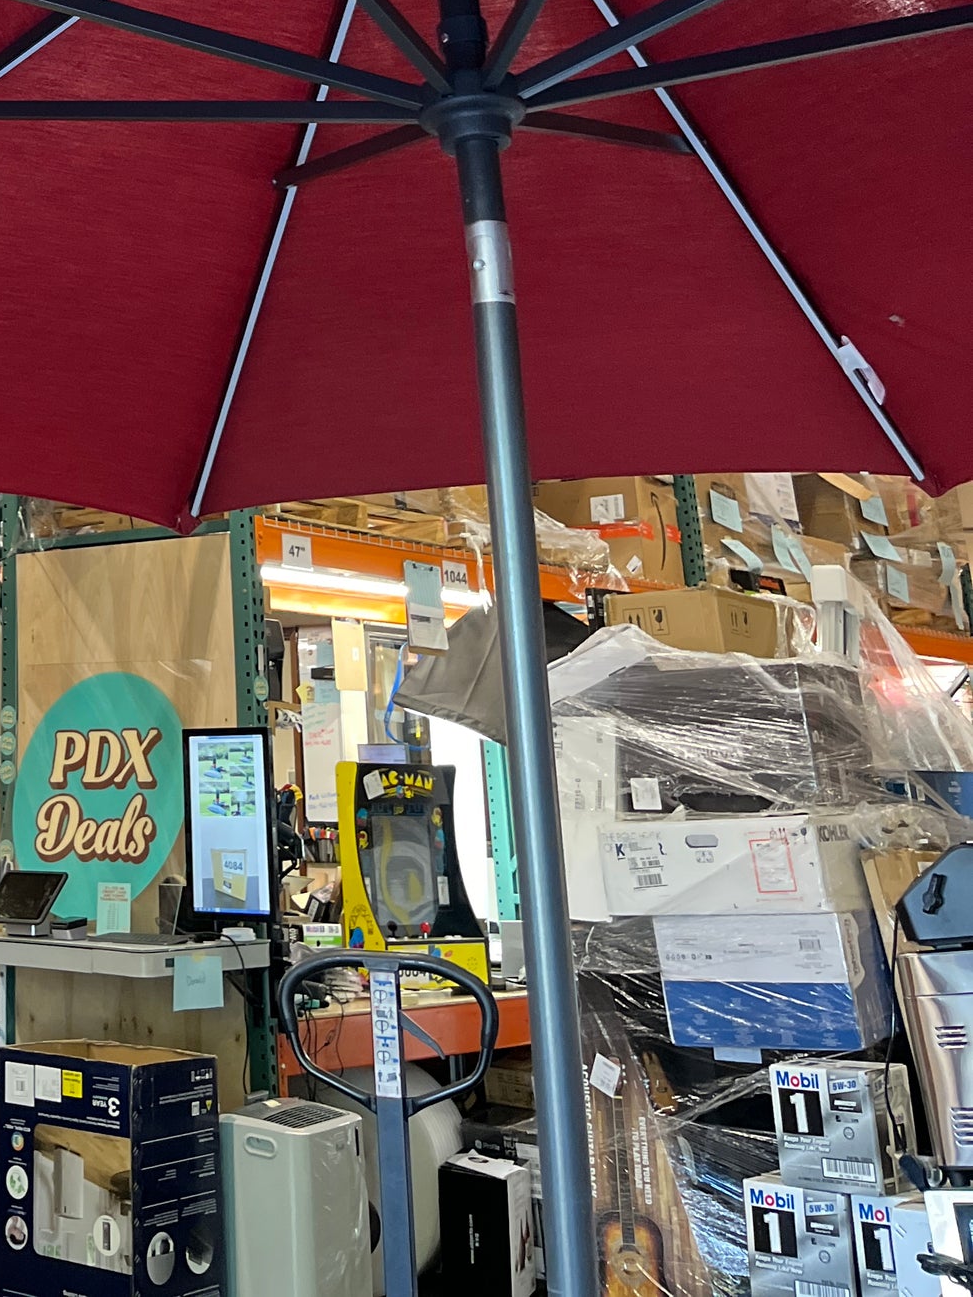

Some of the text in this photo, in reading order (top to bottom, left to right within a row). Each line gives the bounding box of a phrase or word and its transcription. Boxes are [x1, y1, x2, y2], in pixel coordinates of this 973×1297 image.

[288, 545, 305, 558] 47"
[444, 569, 468, 585] 1044
[49, 727, 163, 790] PDX
[381, 770, 433, 791] AC-MAN
[35, 792, 157, 864] Deals
[817, 824, 850, 842] KOHLER
[776, 1070, 820, 1090] Mobil
[832, 1080, 856, 1091] 5W-30
[107, 1097, 121, 1117] 3
[789, 1092, 809, 1133] 1
[749, 1188, 795, 1210] Mobil
[809, 1203, 835, 1213] 5W-30
[764, 1212, 782, 1254] 1
[873, 1227, 894, 1272] 1
